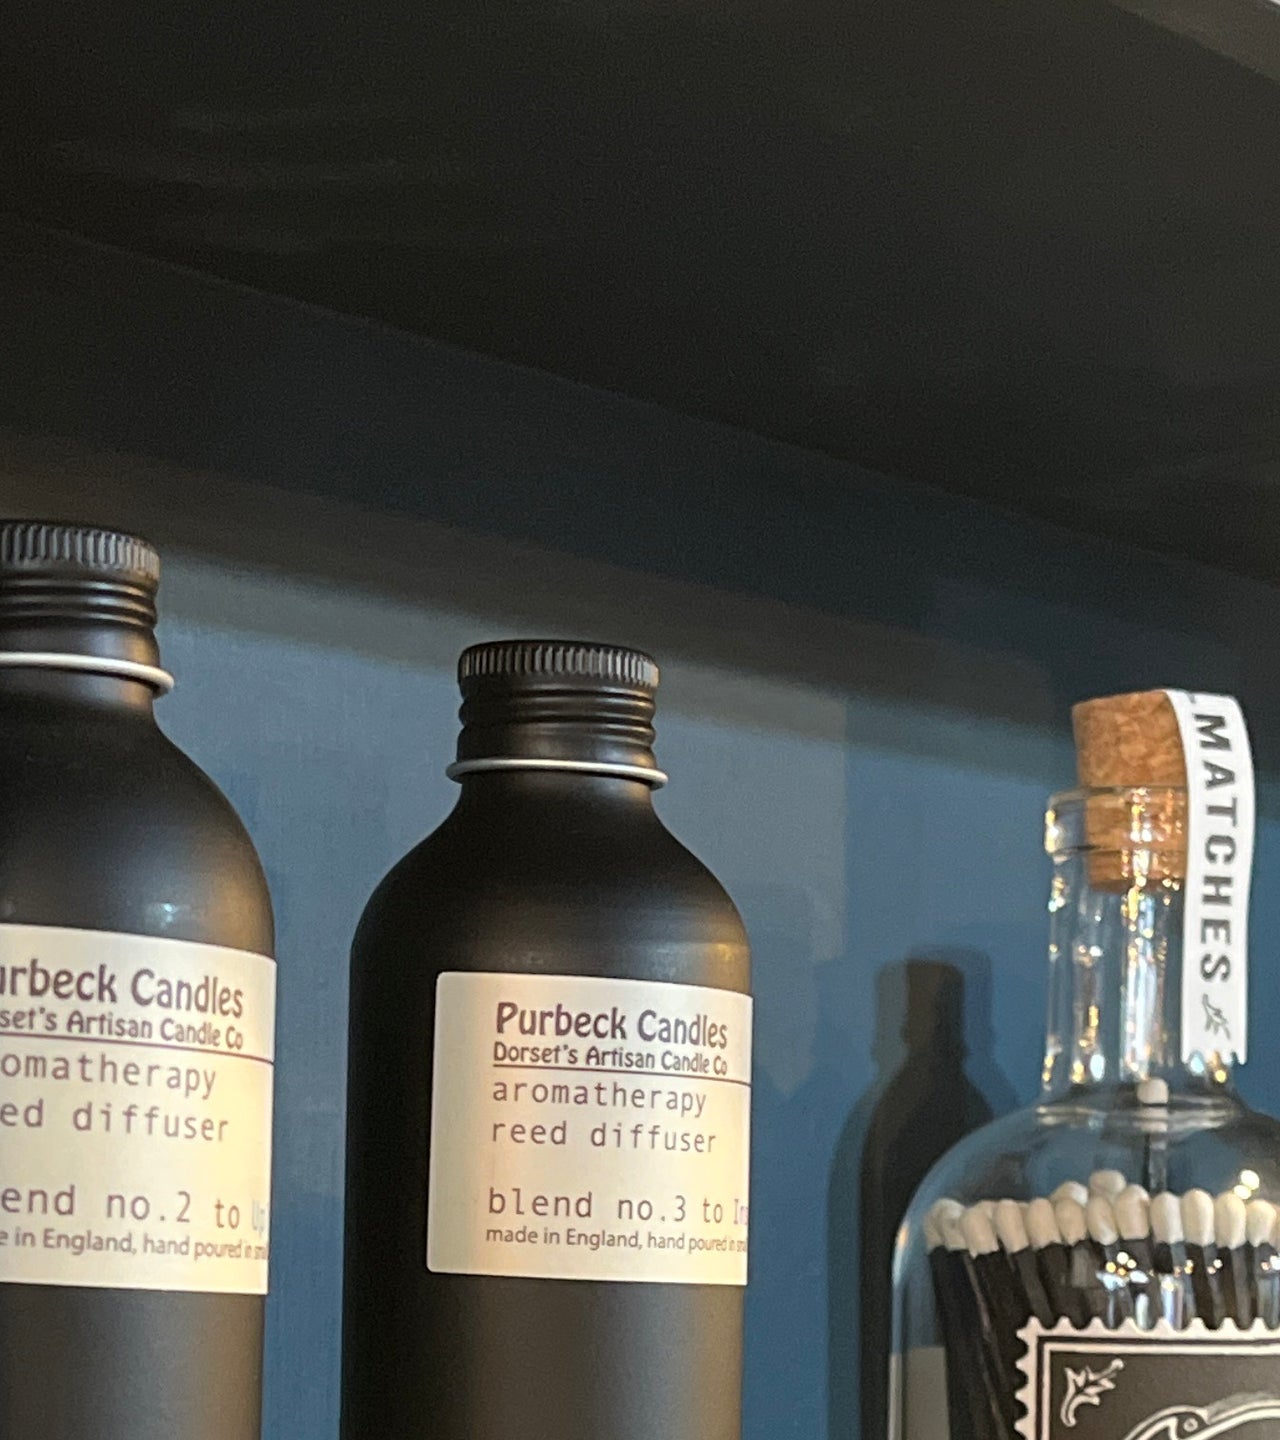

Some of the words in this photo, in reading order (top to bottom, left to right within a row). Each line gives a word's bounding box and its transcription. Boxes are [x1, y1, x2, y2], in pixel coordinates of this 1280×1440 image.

[1194, 712, 1238, 984] MATCHES
[131, 968, 244, 1018] Candles
[66, 1009, 153, 1039] Artisan
[159, 1017, 221, 1047] Candle
[224, 1025, 244, 1051] Co
[496, 1002, 628, 1040] Purbeck
[637, 1009, 728, 1050] Candles
[494, 1041, 579, 1065] Dorset's
[586, 1046, 656, 1070] Artisan
[661, 1050, 710, 1075] Candle
[713, 1054, 728, 1077] Co
[492, 1081, 707, 1118] aromatherapy
[73, 1101, 229, 1142] diffuser
[492, 1120, 567, 1145] reed
[590, 1121, 717, 1153] diffuser
[106, 1190, 192, 1224] no.2
[214, 1198, 241, 1230] to
[488, 1187, 593, 1218] blend
[617, 1194, 687, 1223] no.3
[703, 1198, 724, 1225] to
[15, 1226, 36, 1247] in
[43, 1229, 138, 1255] England,
[143, 1234, 190, 1256] hand
[193, 1238, 242, 1262] poured
[486, 1226, 538, 1244] made
[544, 1227, 560, 1245] in
[566, 1228, 643, 1251] England,
[647, 1231, 685, 1250] hand
[688, 1235, 727, 1255] poured
